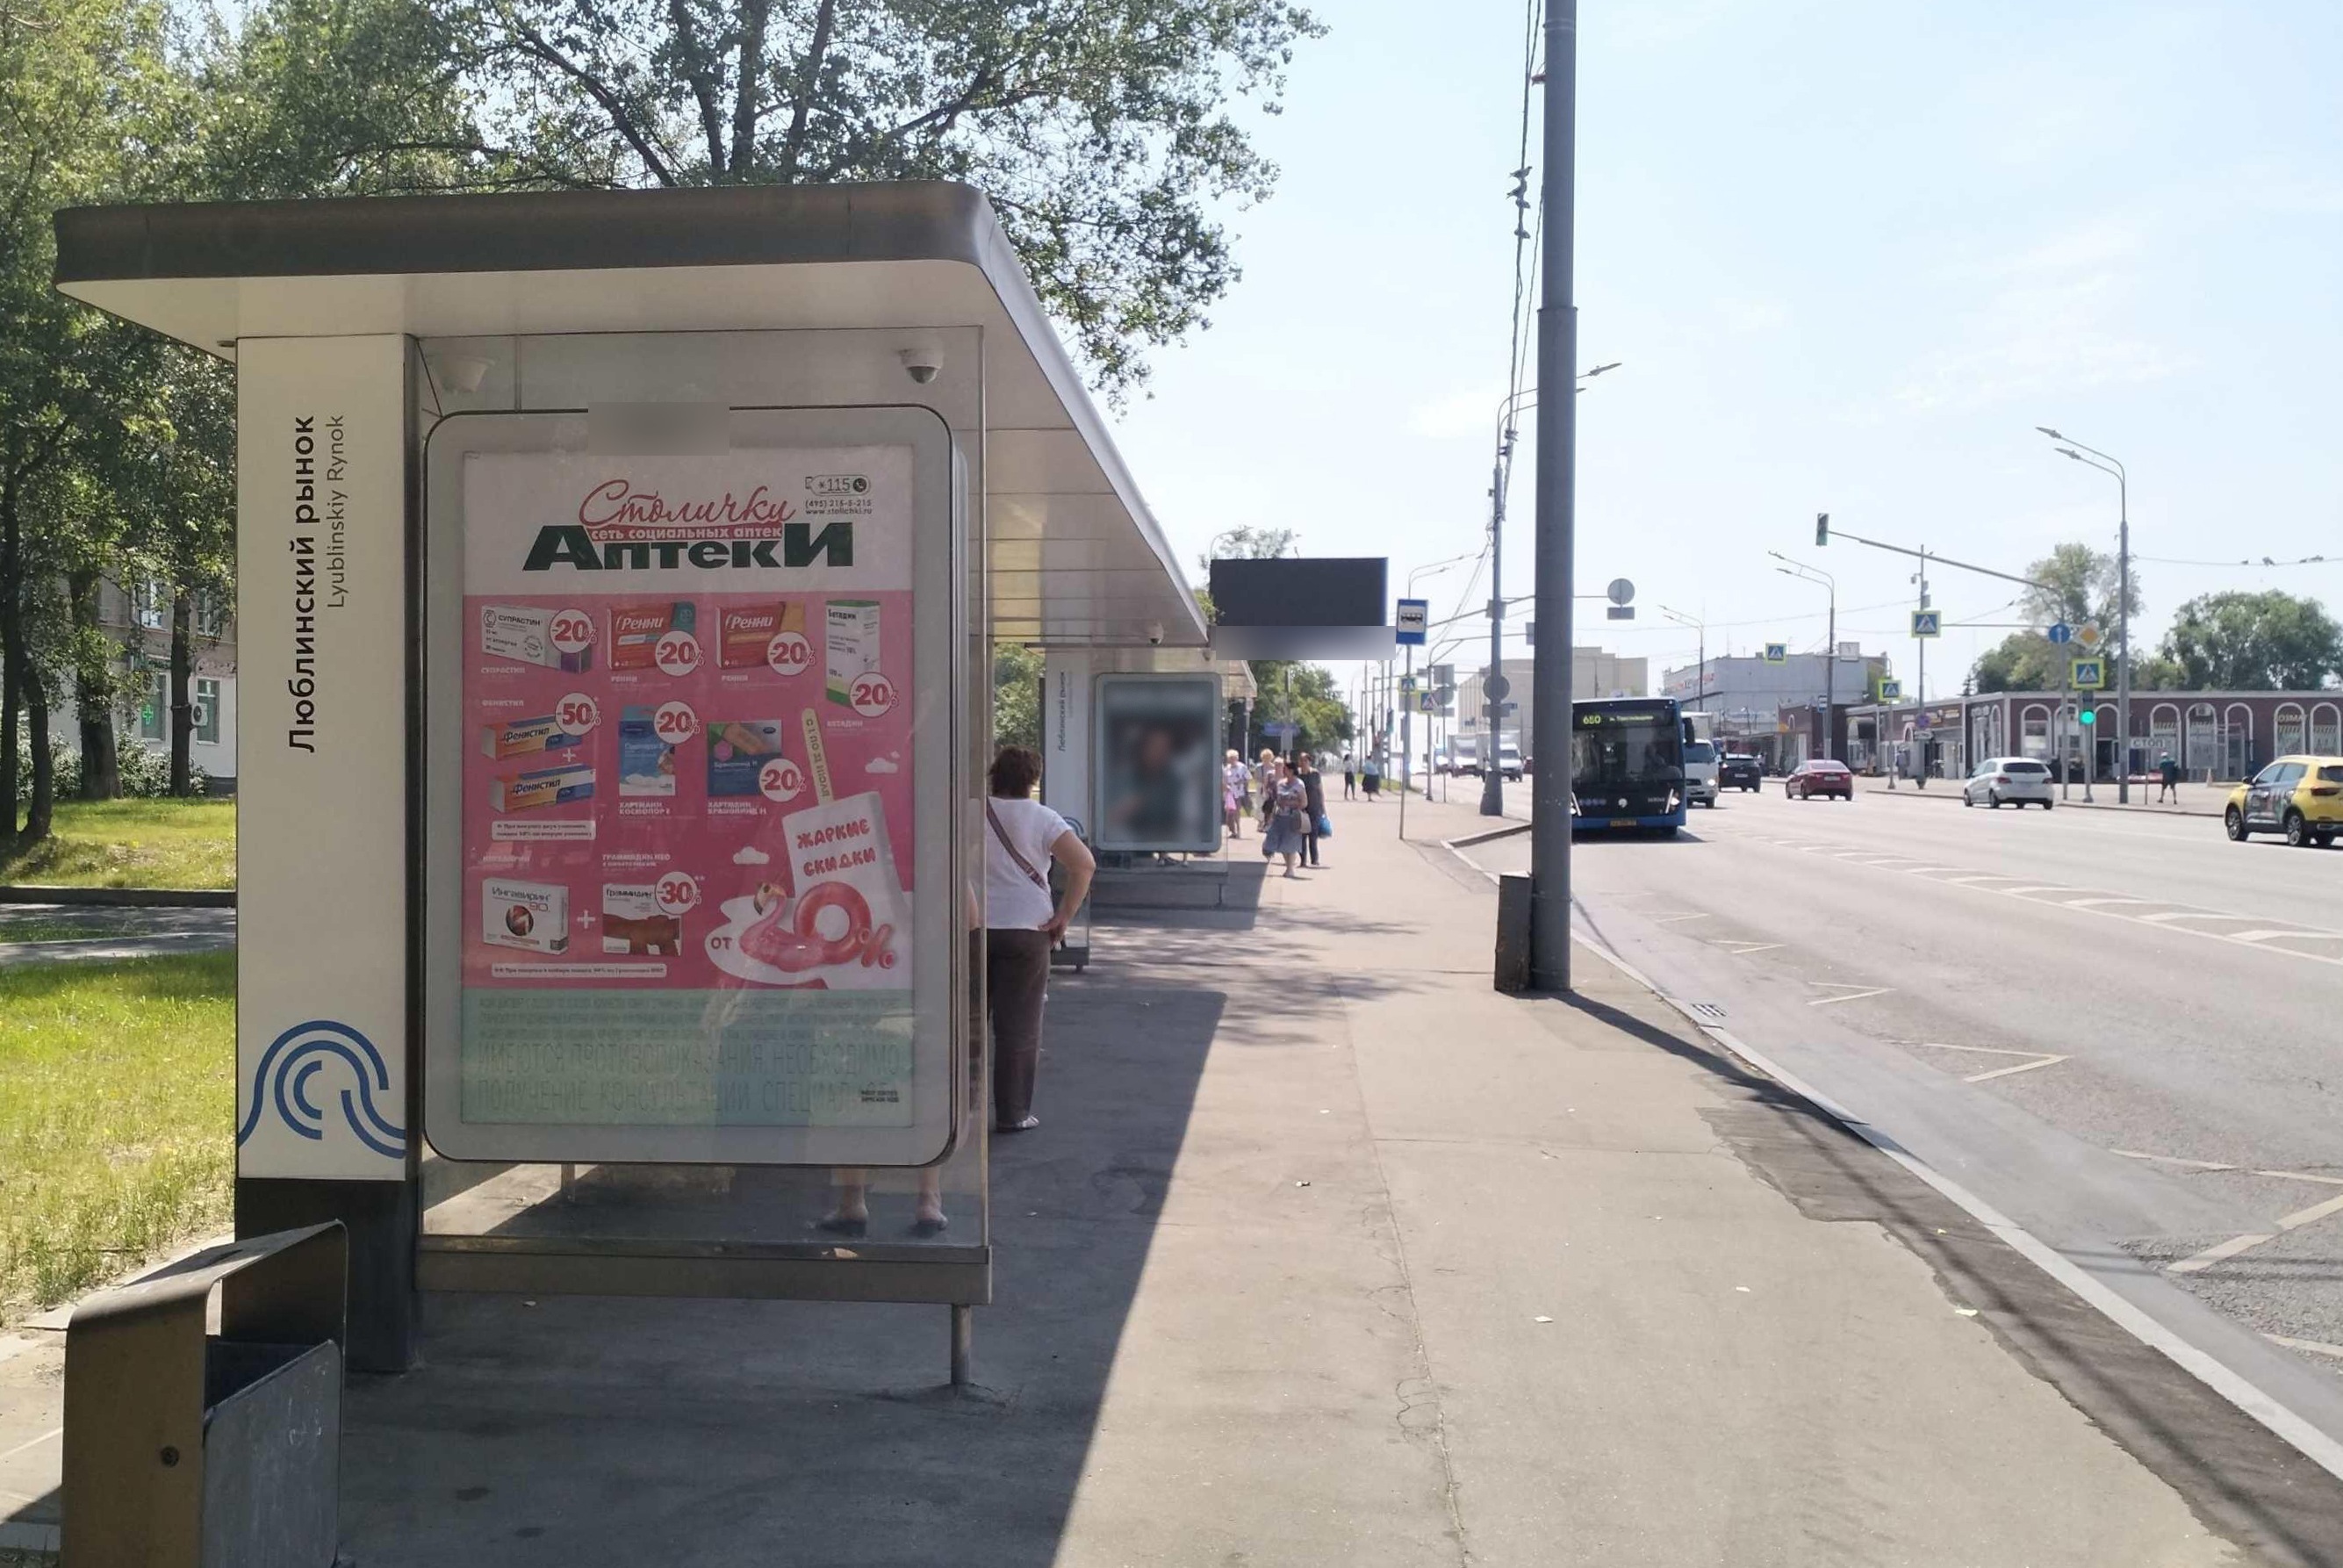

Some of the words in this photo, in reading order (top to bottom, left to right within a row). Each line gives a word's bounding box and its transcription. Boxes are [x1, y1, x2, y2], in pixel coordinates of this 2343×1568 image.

[326, 415, 348, 481] Rynok
[295, 416, 320, 522] рынок
[579, 479, 796, 526] Столички
[591, 528, 624, 540] сеть
[629, 528, 730, 540] социальных
[733, 527, 782, 538] аптек
[326, 490, 349, 608] Lyublinskiy
[498, 615, 541, 626] СУПРАСТИН
[621, 617, 665, 630] Ренни
[729, 616, 773, 629] Ренни
[288, 537, 315, 753] Люблинский
[502, 728, 550, 743] Фенистил
[512, 779, 562, 795] Фенистил
[797, 818, 871, 849] ЖАРКИЕ
[803, 847, 876, 877] СКИДКИ
